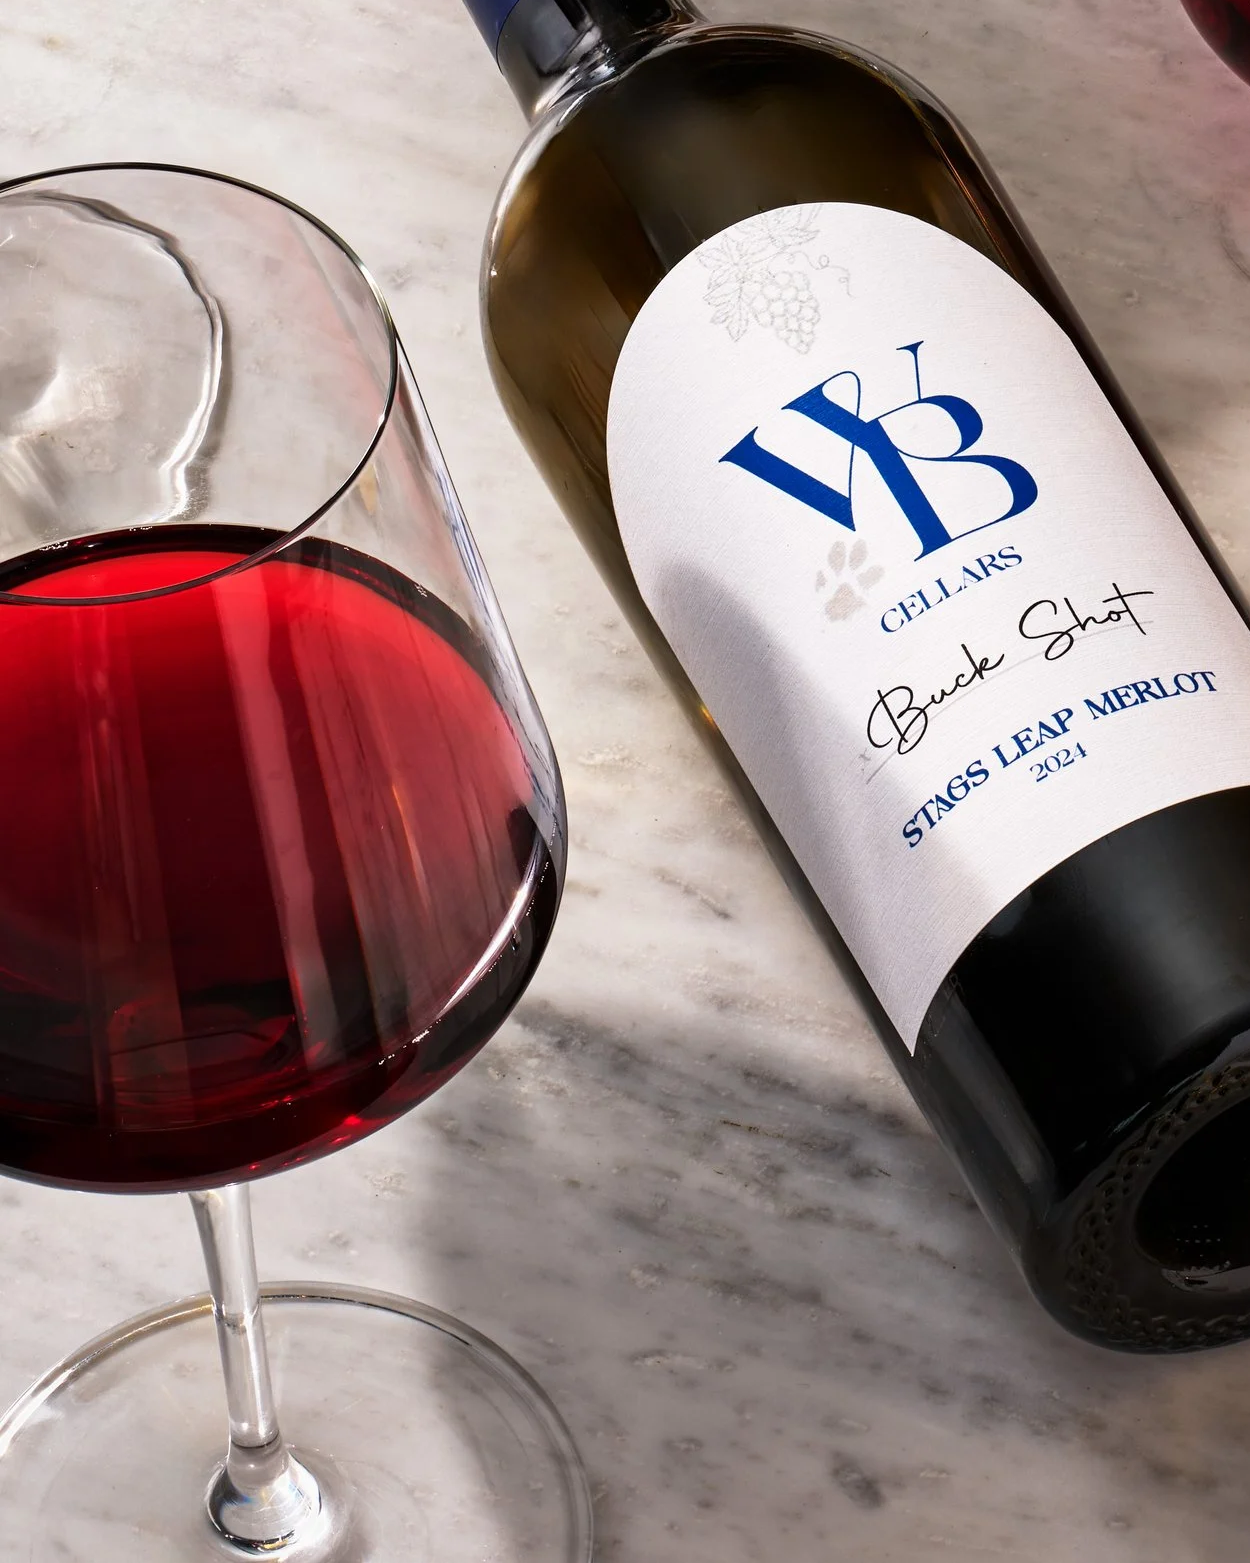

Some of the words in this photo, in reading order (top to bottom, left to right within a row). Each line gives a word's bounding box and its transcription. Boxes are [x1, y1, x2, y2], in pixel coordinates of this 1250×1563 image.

[879, 545, 1023, 634] CELLARS
[866, 643, 1005, 755] Buck
[1018, 582, 1155, 662] Shot
[902, 759, 990, 848] STAGS
[991, 707, 1075, 770] LEAP
[1084, 669, 1218, 721] MERLOT
[1028, 741, 1089, 783] 2024
